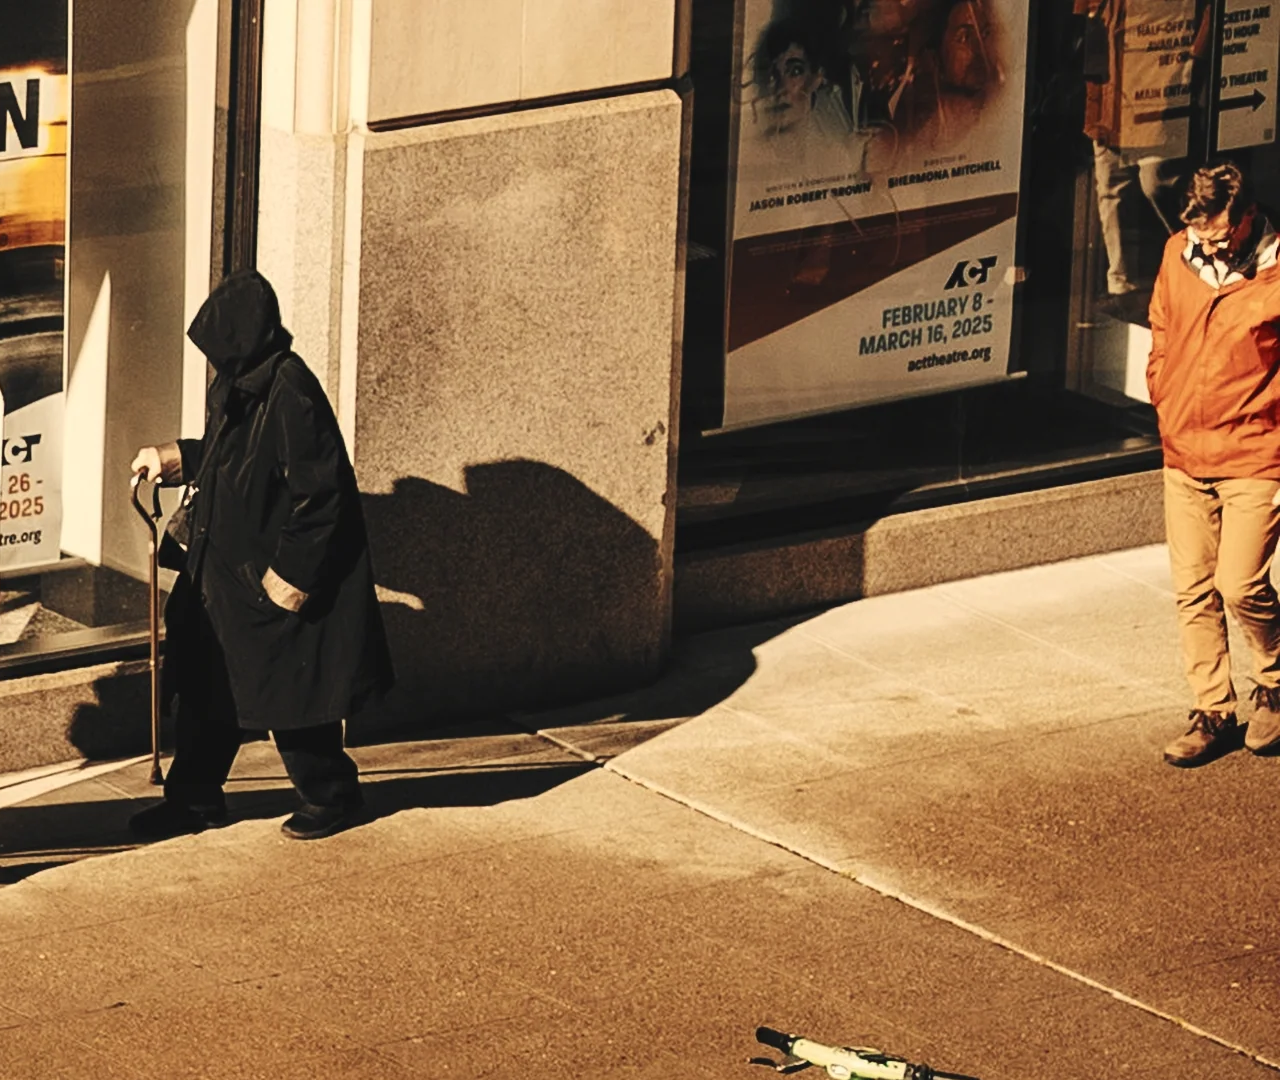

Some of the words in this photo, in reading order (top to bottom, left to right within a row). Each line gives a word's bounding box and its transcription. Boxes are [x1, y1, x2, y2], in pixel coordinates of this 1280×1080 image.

[749, 197, 784, 212] JASON
[786, 189, 828, 205] ROBERT
[951, 160, 1001, 177] MITCHELL
[944, 256, 997, 290] ACT
[882, 293, 968, 329] FEBRUARY
[972, 292, 982, 312] 8
[859, 327, 922, 356] MARCH
[927, 324, 947, 344] 16,
[952, 314, 992, 339] 2025
[907, 347, 991, 373] acttheatre.org
[8, 473, 30, 495] 26
[0, 496, 44, 521] 2025
[0, 530, 42, 547] tre.org
